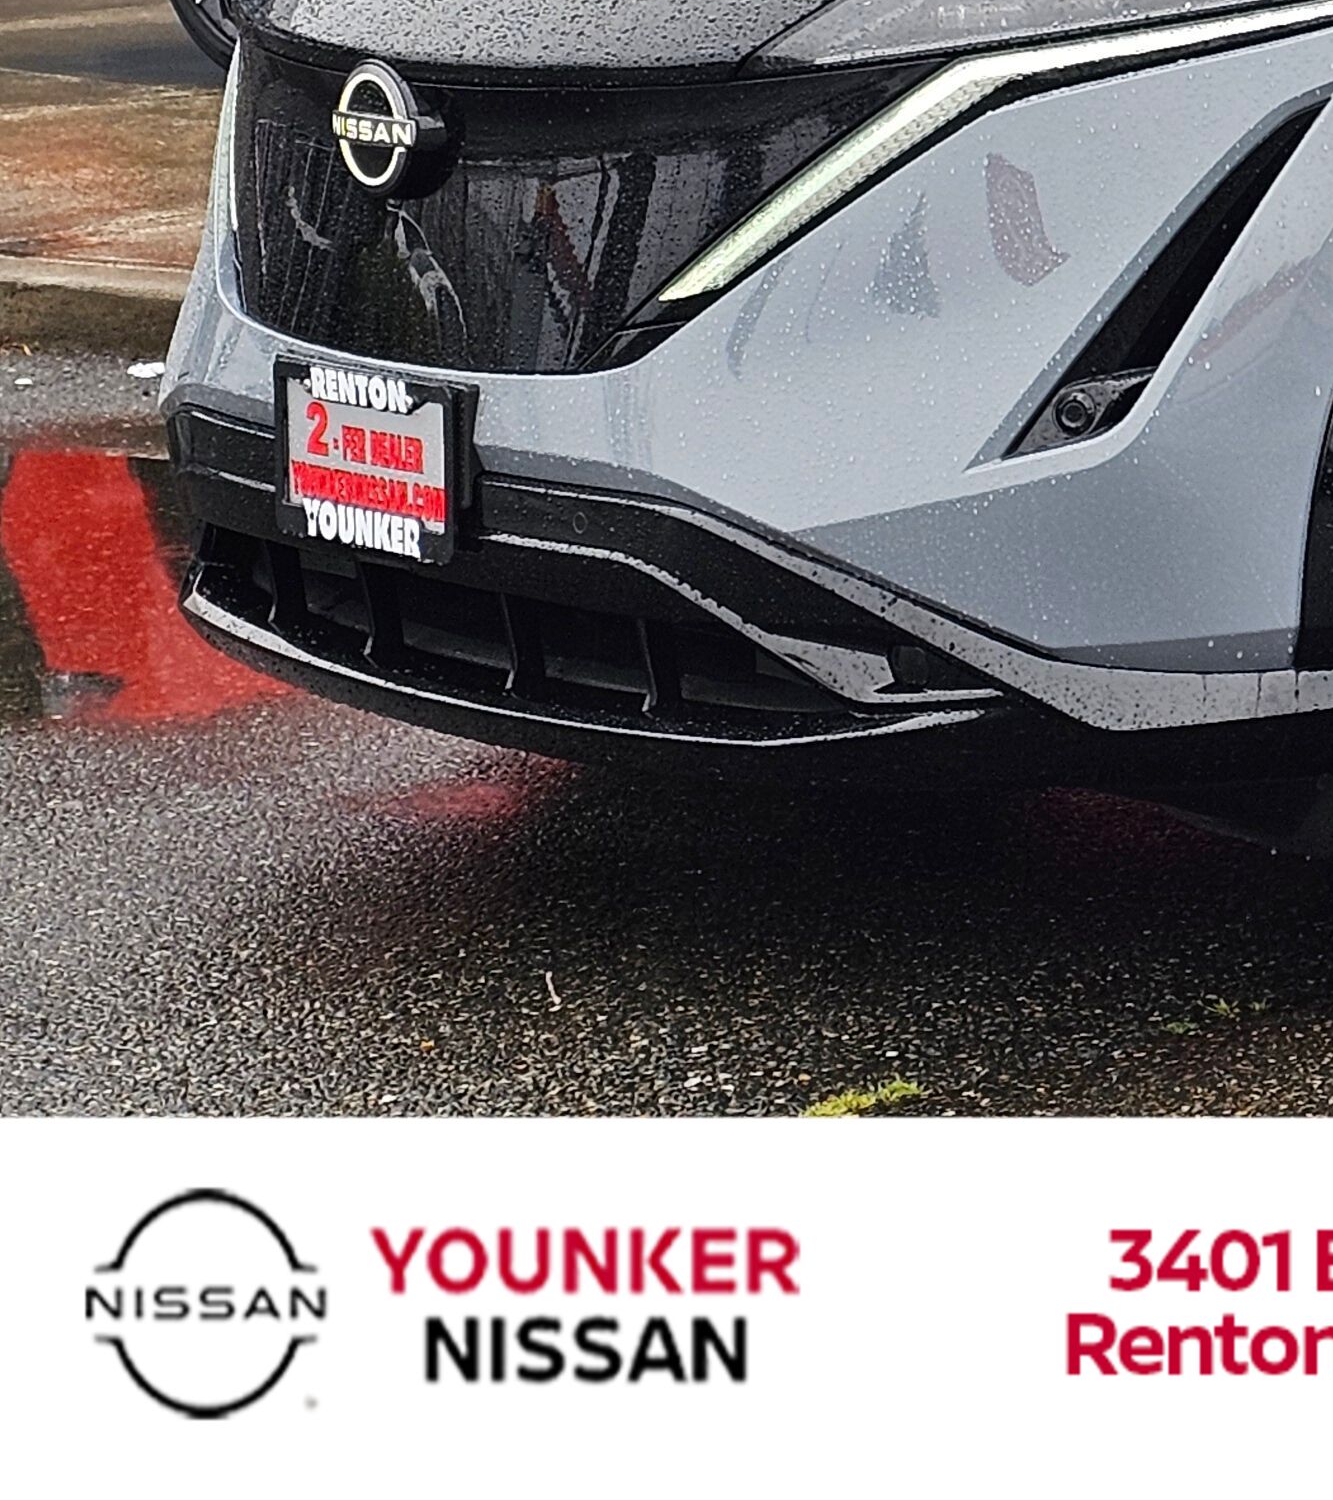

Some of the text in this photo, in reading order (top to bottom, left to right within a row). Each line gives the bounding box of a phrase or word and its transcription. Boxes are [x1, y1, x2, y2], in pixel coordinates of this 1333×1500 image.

[331, 113, 414, 147] NISSAN
[309, 366, 408, 414] RENTON
[302, 497, 421, 559] YOUNKER
